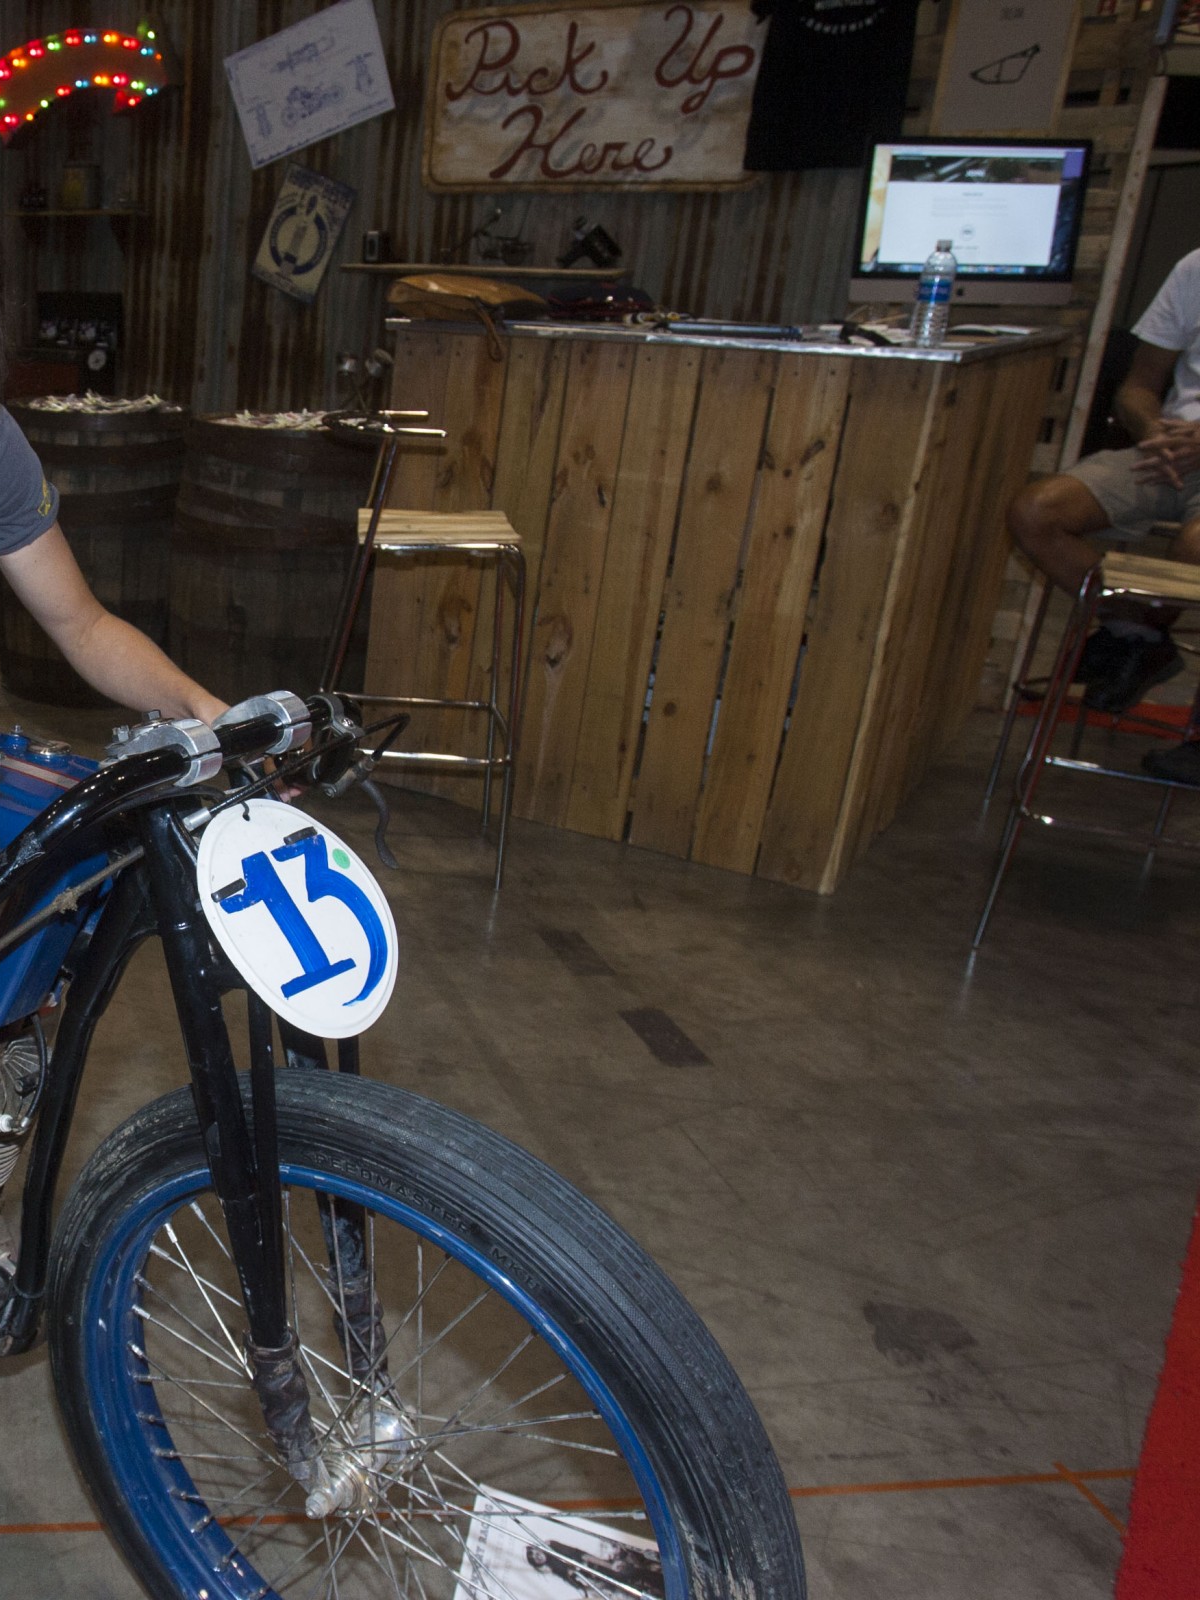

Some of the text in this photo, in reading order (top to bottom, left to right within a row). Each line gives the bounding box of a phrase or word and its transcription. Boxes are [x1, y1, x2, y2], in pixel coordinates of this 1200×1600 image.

[445, 6, 754, 114] Pick Up
[490, 104, 672, 178] Here
[220, 834, 388, 1006] 13
